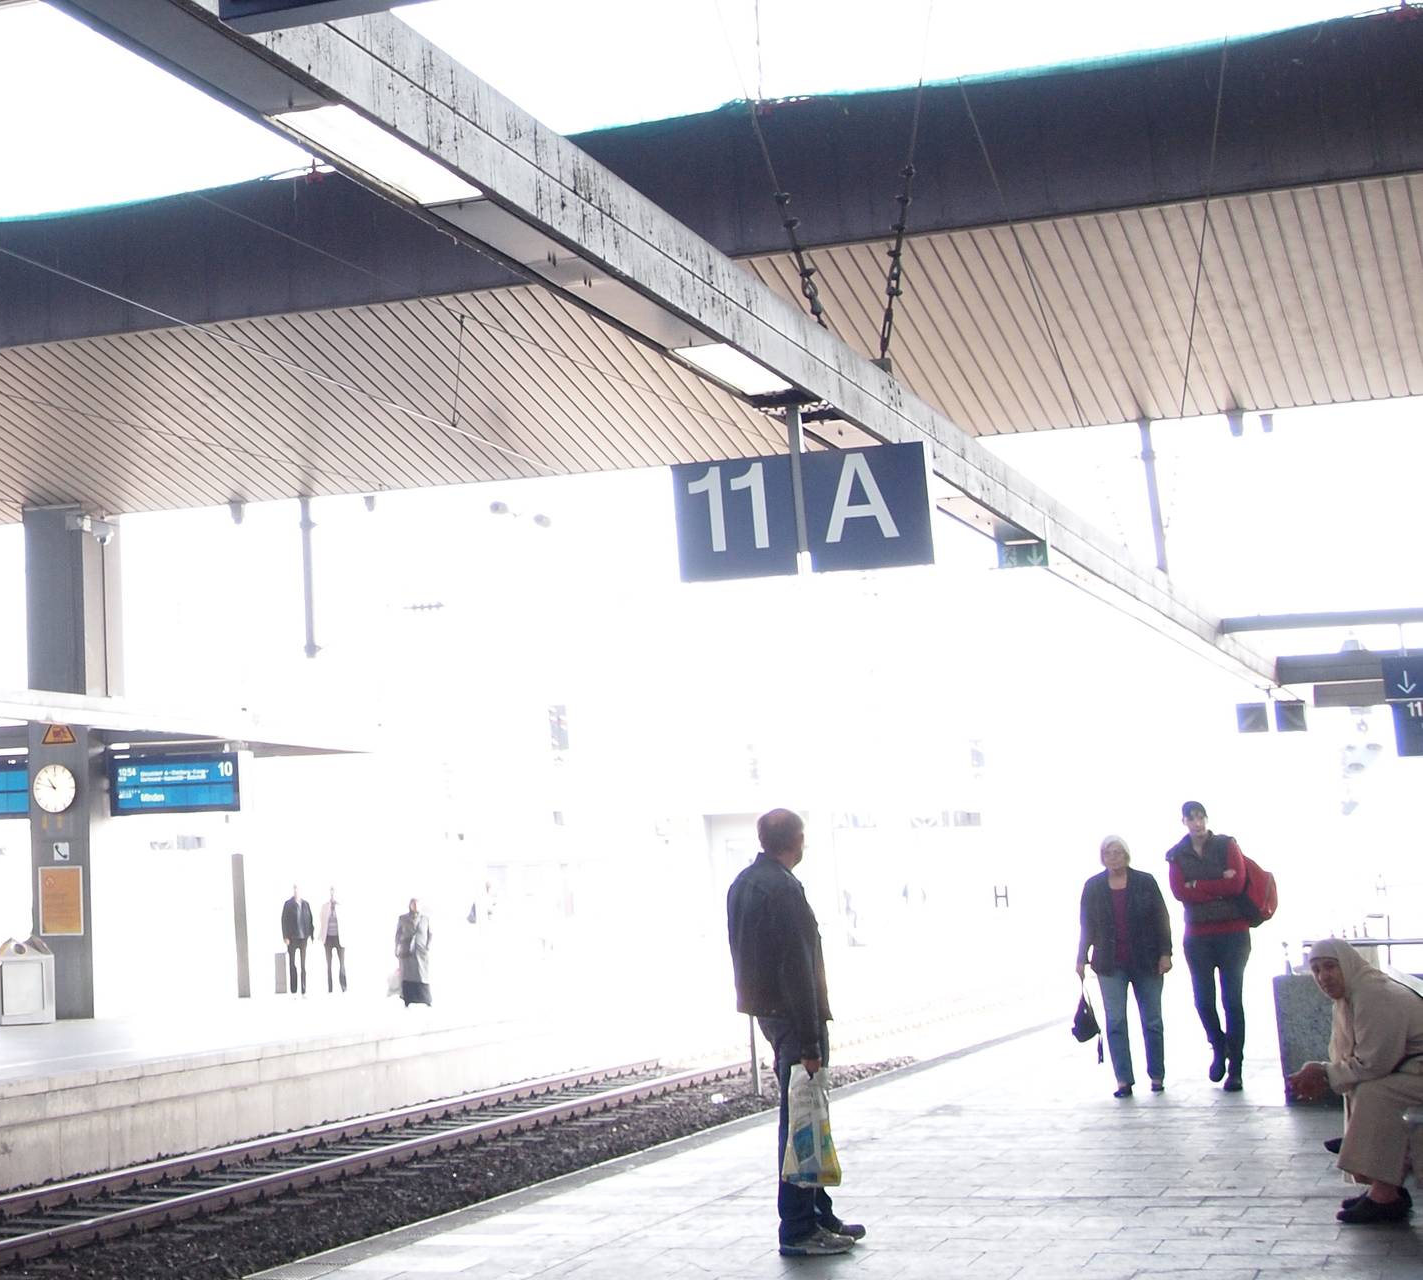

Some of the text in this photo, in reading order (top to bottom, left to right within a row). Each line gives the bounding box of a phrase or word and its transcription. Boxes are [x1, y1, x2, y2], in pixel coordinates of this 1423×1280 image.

[687, 452, 900, 552] 11 A
[217, 761, 233, 777] 10
